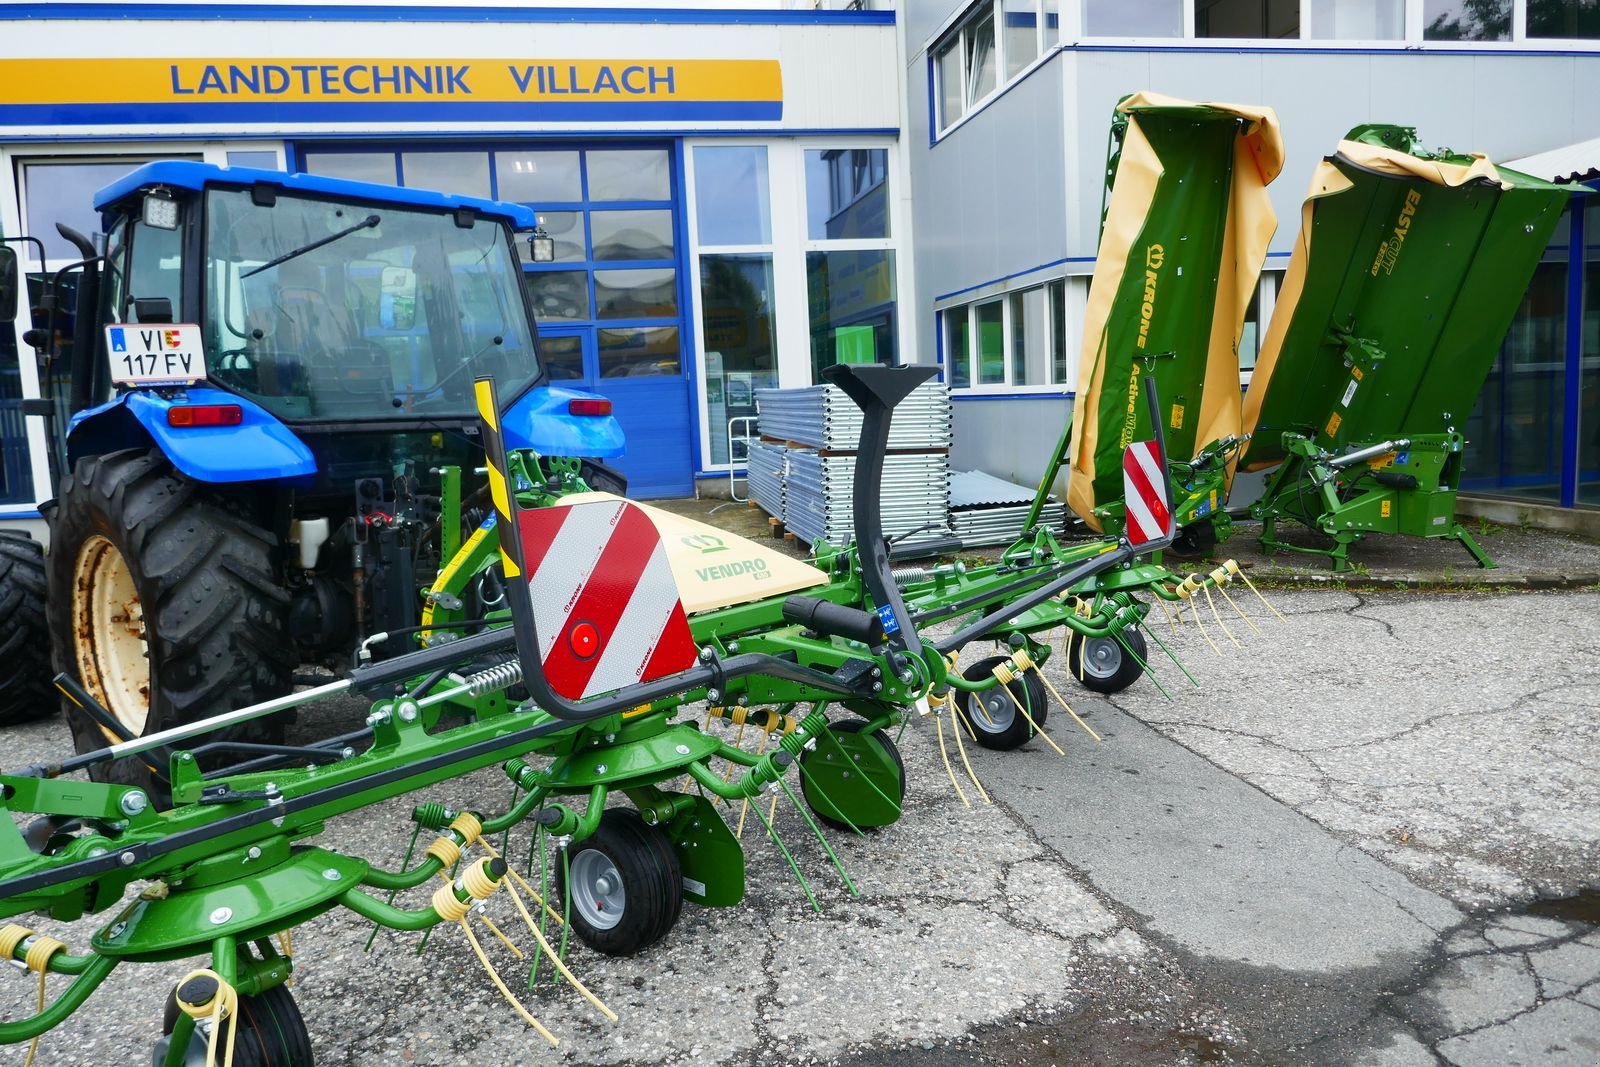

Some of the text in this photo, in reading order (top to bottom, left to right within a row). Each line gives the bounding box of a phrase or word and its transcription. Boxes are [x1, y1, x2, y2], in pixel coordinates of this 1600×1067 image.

[170, 65, 675, 94] LANDTECHNIK VILLACH
[1381, 188, 1421, 275] EASYCUT
[1137, 269, 1157, 349] KRONE
[140, 330, 162, 351] VI
[123, 353, 191, 376] 117 FV
[695, 558, 767, 582] VENDRO
